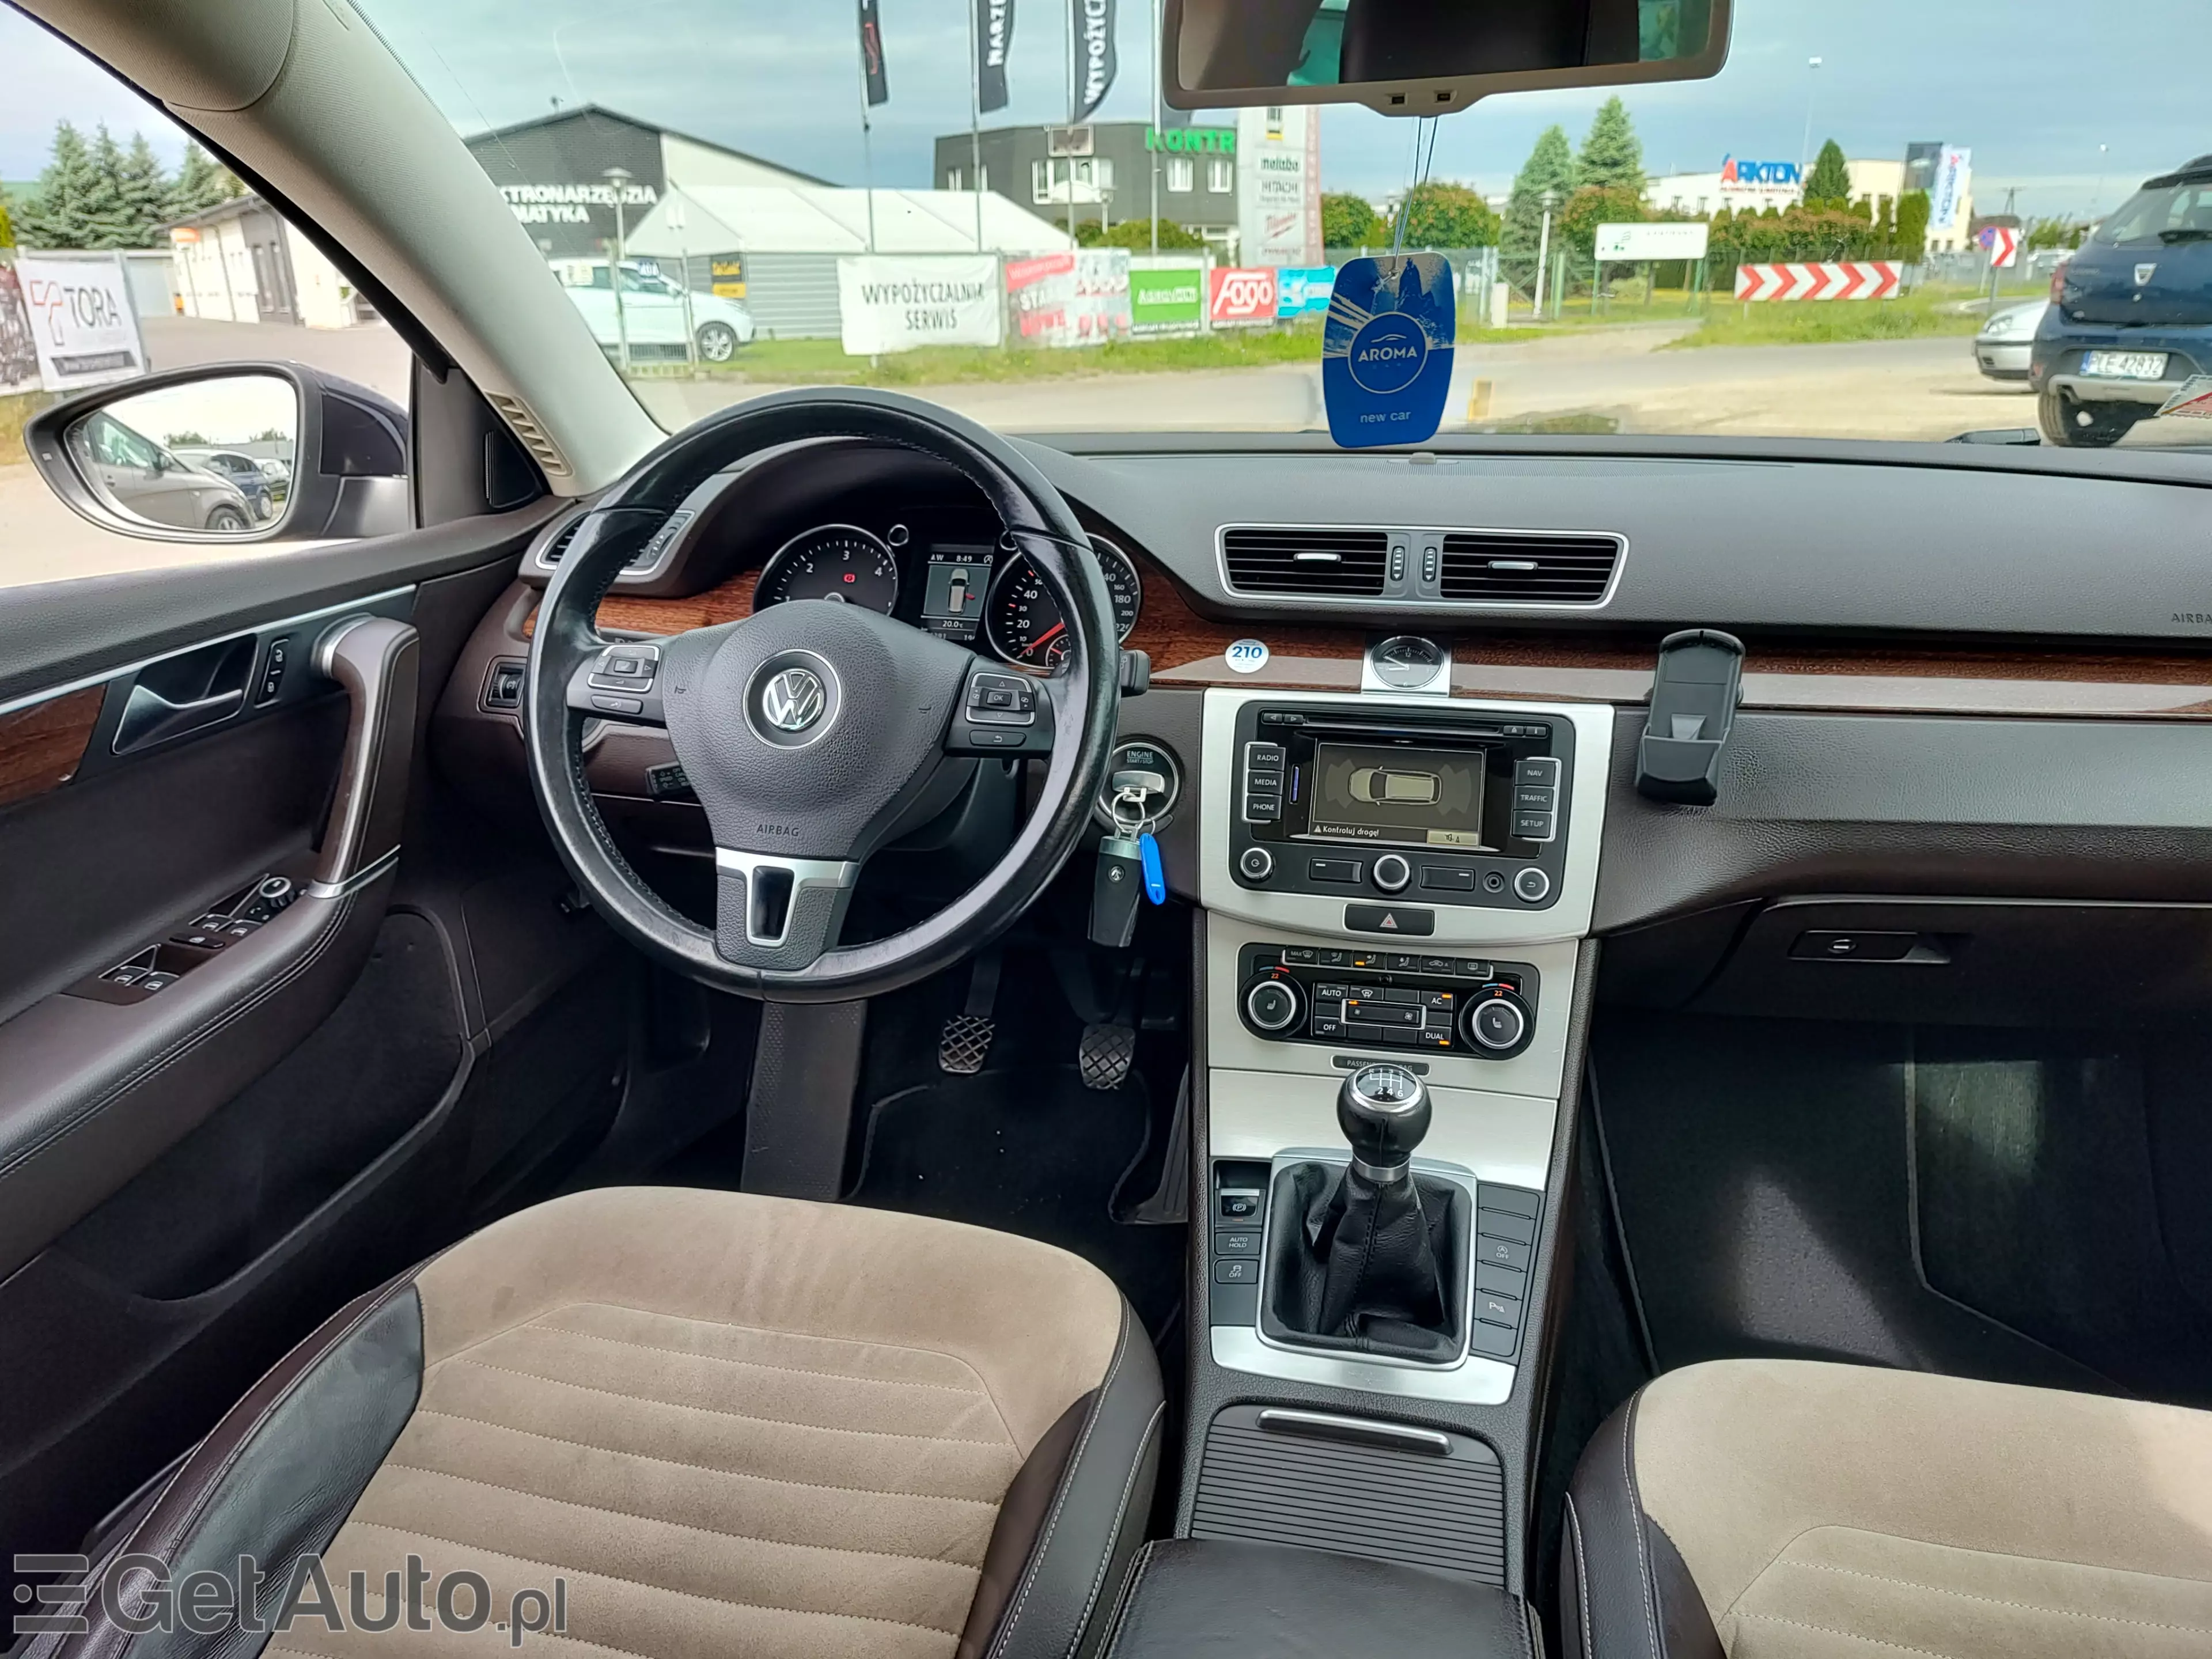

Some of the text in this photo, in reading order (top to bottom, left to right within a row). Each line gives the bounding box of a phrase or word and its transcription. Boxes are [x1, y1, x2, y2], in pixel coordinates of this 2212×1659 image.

[63, 287, 123, 328] TORA
[905, 308, 957, 330] SERWIS
[1358, 346, 1418, 362] AROMA
[1360, 411, 1411, 423] new car
[842, 551, 850, 560] 3
[806, 563, 813, 573] 2
[874, 567, 882, 576] 4
[1024, 590, 1037, 599] 40
[1114, 595, 1131, 604] 180
[1017, 619, 1030, 628] 20
[1026, 648, 1033, 656] 0
[1232, 646, 1262, 658] 210
[756, 824, 800, 837] AIRBAG
[1323, 825, 1380, 837] Kontroluj drogę!
